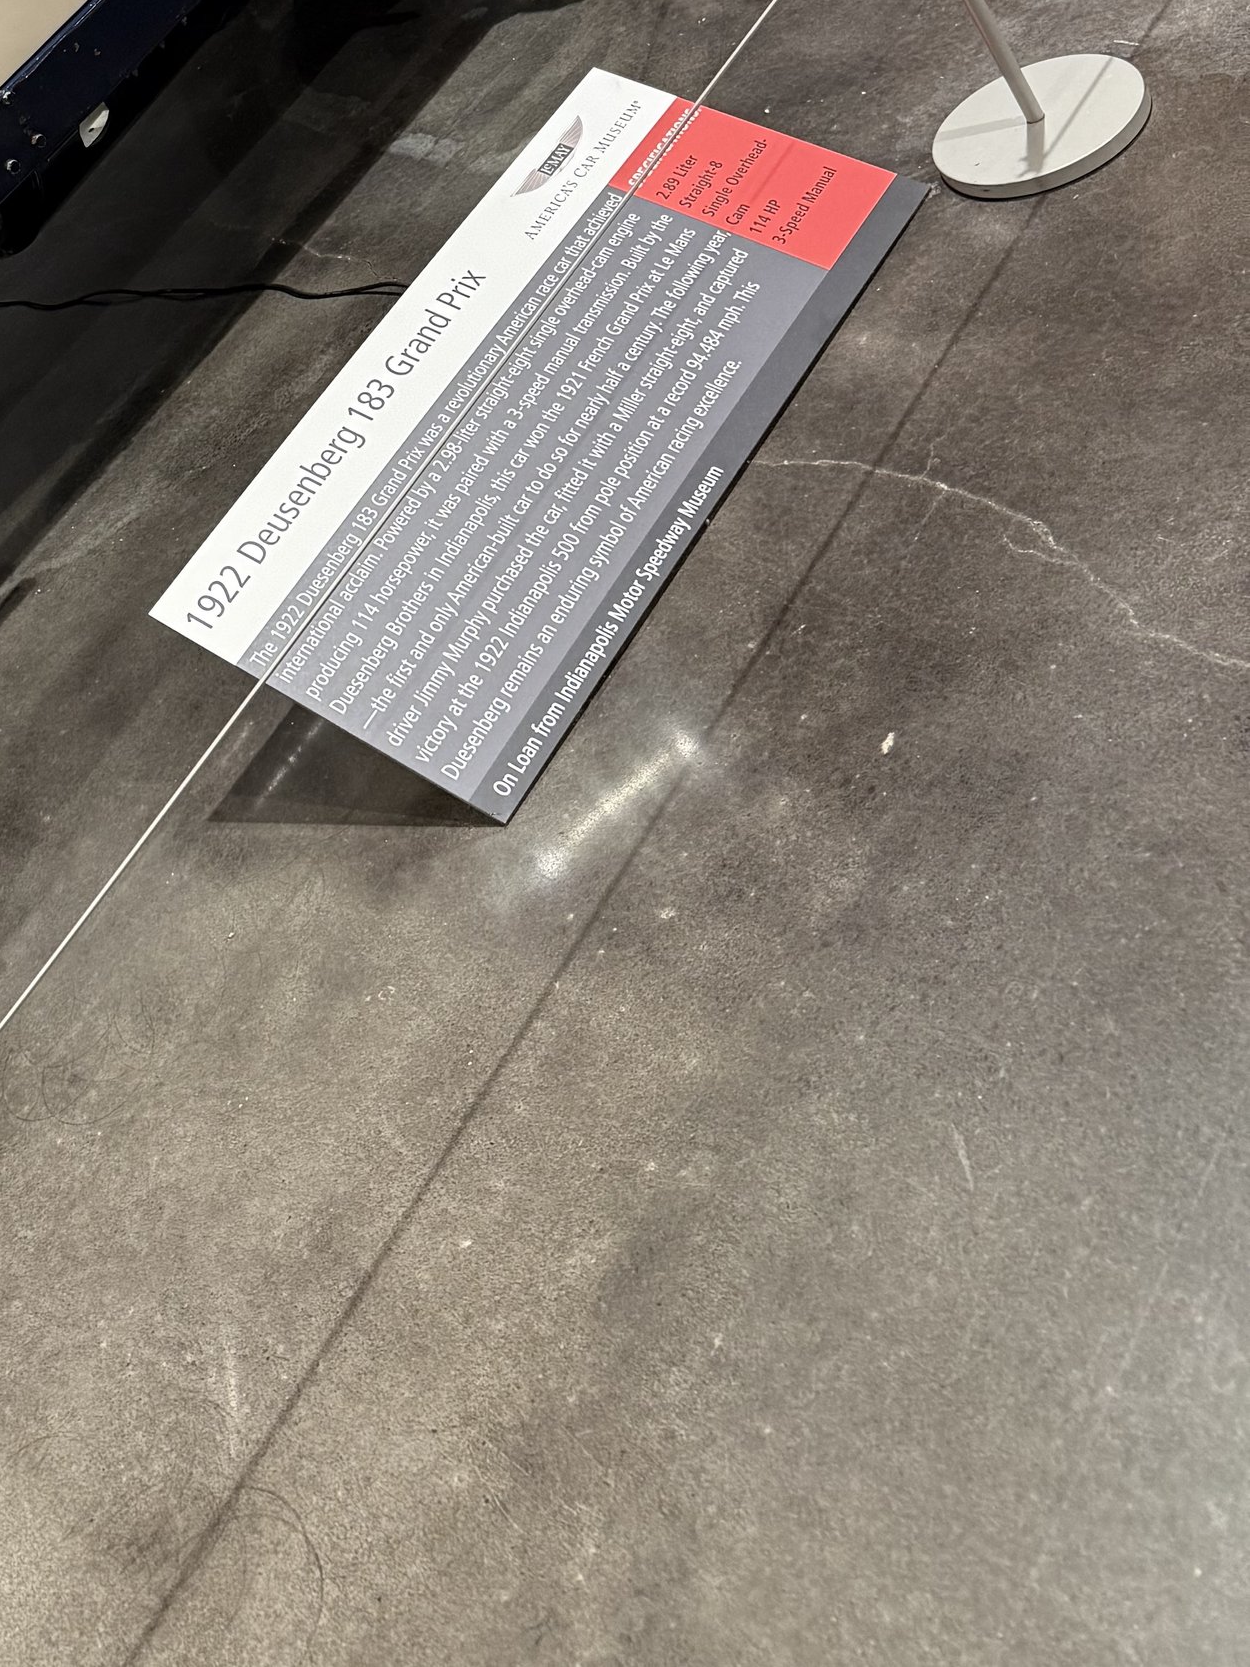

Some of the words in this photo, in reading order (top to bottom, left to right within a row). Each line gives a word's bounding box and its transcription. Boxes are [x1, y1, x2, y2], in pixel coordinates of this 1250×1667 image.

[573, 155, 599, 177] CAR
[656, 178, 679, 199] 2.89
[673, 155, 697, 176] Liter
[679, 160, 722, 207] Straight-8
[702, 187, 732, 216] Single
[726, 139, 766, 184] Overhead-
[608, 213, 640, 245] engine
[725, 204, 749, 224] Cam
[749, 215, 770, 232] 114
[763, 199, 779, 214] HP
[772, 202, 809, 244] 3-Speed
[801, 166, 836, 202] Manual
[554, 247, 614, 315] overhead-cam
[529, 316, 560, 347] single
[475, 346, 536, 419] straight-eight
[693, 361, 741, 416] excellence.
[187, 566, 250, 628] 1922
[236, 426, 365, 563] Deusenberg
[348, 379, 394, 420] 183
[385, 308, 451, 375] Grand
[436, 270, 486, 309] Prix
[432, 418, 480, 471] 2.98-liter
[667, 416, 703, 452] racing
[410, 481, 435, 498] by
[428, 472, 441, 481] a
[626, 453, 675, 509] American
[371, 495, 421, 550] Powered
[619, 503, 636, 521] of
[589, 520, 626, 567] symbol
[334, 553, 382, 600] acclaim.
[550, 567, 599, 623] enduring
[268, 598, 344, 682] international
[493, 773, 517, 795] On
[508, 737, 542, 773] Loan
[531, 702, 564, 736] from
[554, 621, 618, 702] Indianapolis
[607, 579, 644, 621] Motor
[635, 517, 690, 580] Speedway
[677, 466, 723, 517] Museum
[537, 625, 556, 643] an
[500, 643, 542, 697] remains
[441, 697, 510, 779] Duesenberg
